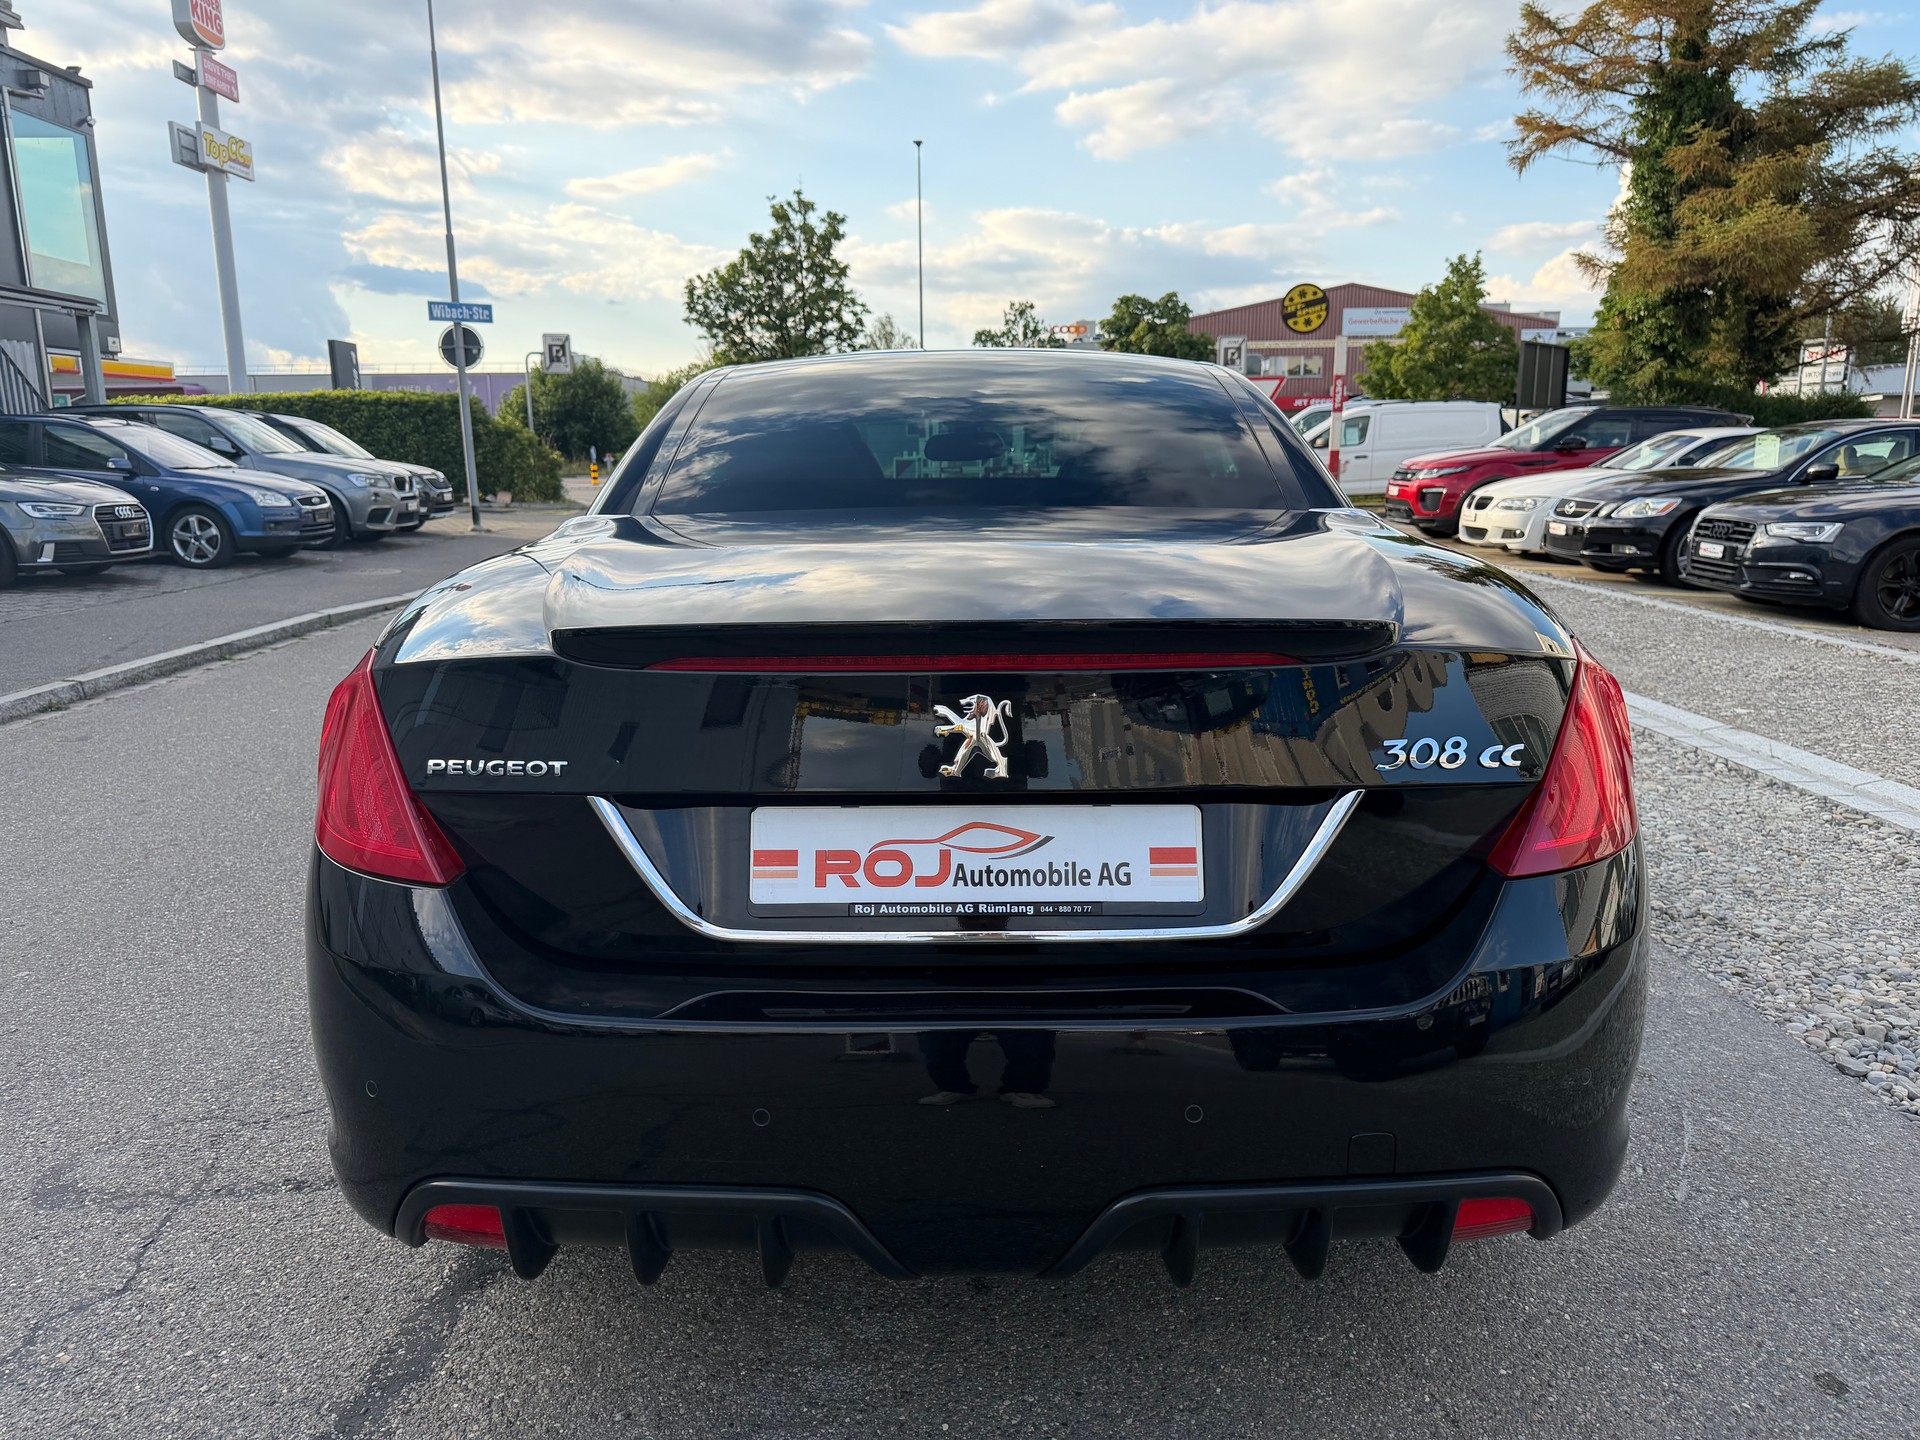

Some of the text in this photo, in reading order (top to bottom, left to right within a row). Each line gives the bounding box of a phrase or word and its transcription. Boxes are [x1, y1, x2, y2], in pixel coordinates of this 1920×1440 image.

[190, 0, 223, 35] KING
[431, 304, 490, 320] Wibach-Str.
[1050, 325, 1088, 337] coop
[1375, 736, 1468, 770] 308
[426, 759, 568, 777] PEUGEOT
[815, 849, 1132, 888] ROJ Automobile AG
[855, 904, 875, 916] Roj
[880, 904, 952, 914] Automobile
[956, 904, 974, 913] AG
[979, 904, 1034, 915] Rümlang
